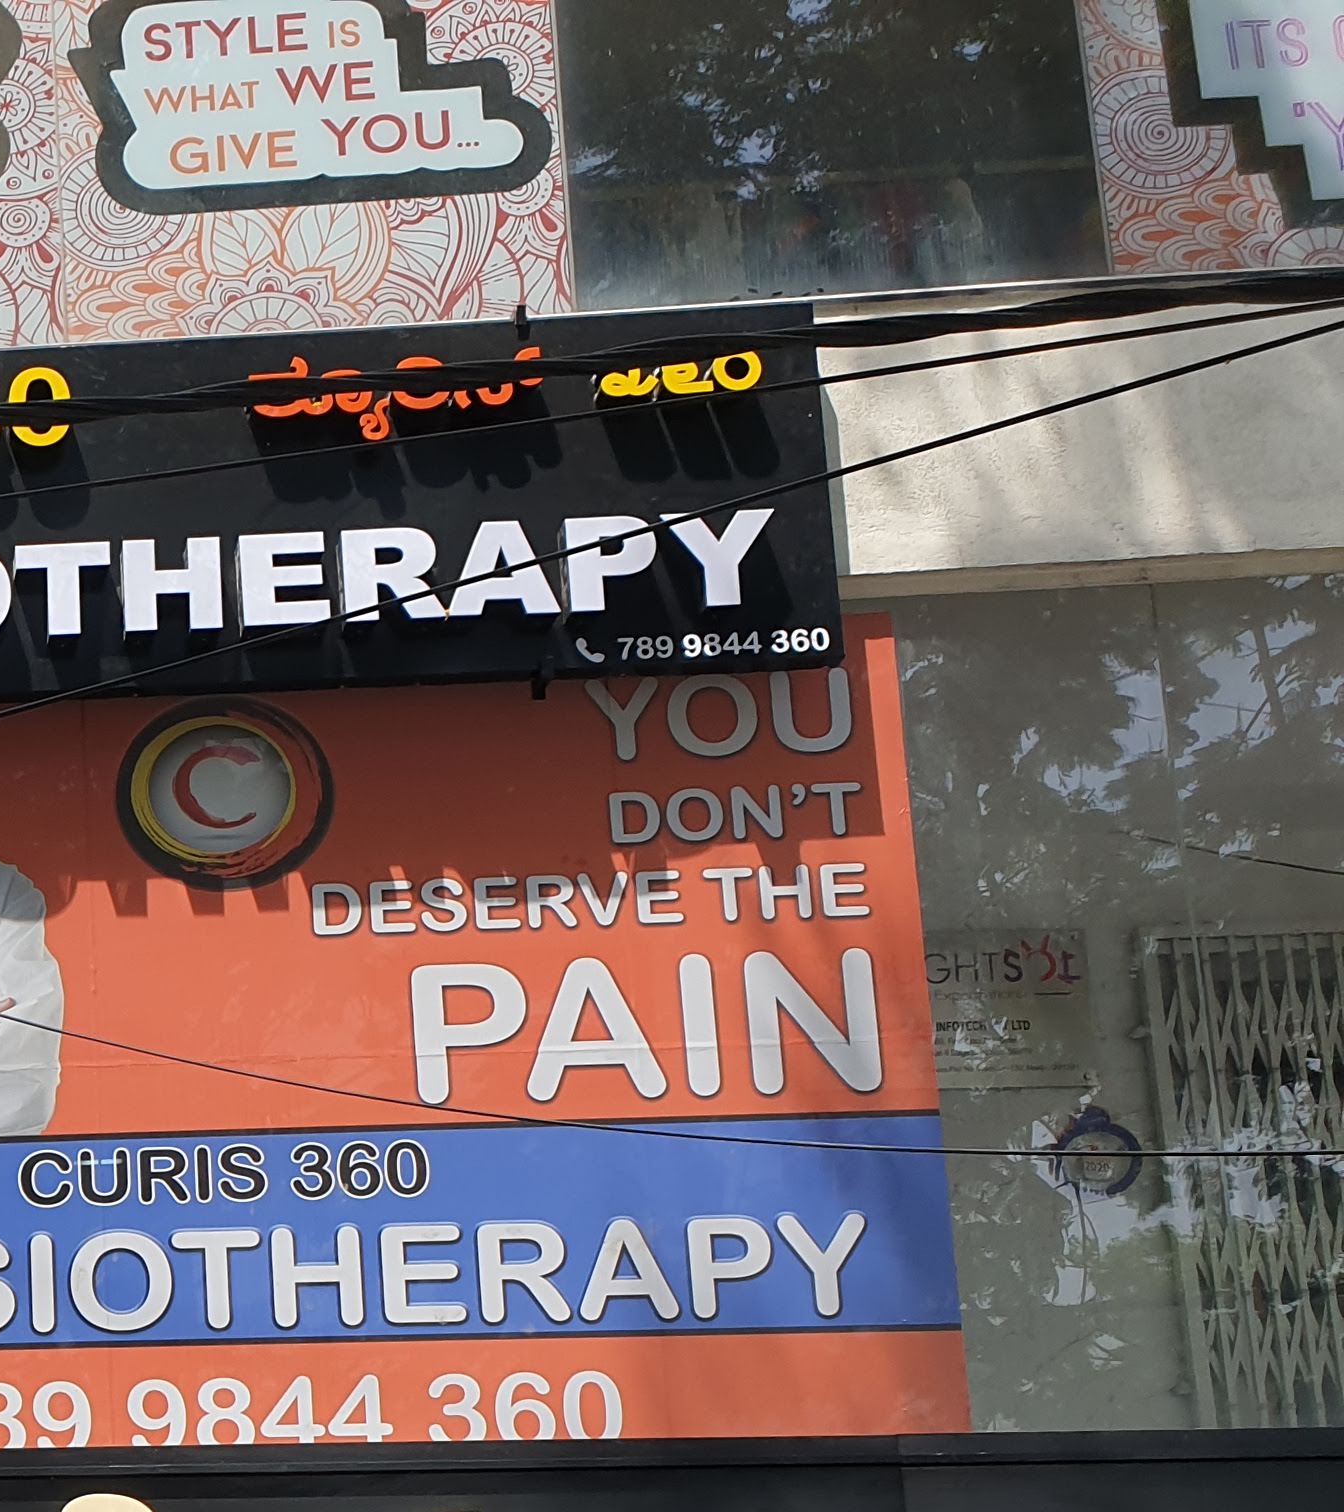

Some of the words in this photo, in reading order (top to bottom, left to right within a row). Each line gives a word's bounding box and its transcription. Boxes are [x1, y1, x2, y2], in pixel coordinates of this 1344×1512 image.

[143, 11, 305, 62] STYLE
[327, 20, 361, 49] IS
[1225, 18, 1309, 70] ITS
[143, 81, 259, 115] WHAT
[275, 61, 375, 102] WE
[168, 128, 298, 172] GIVE
[616, 635, 675, 661] 789
[682, 631, 763, 658] 9844
[770, 626, 832, 655] 360
[584, 665, 855, 763] YOU
[311, 868, 686, 937] DESERVE
[703, 862, 871, 924] THE
[410, 947, 884, 1106] PAIN
[17, 1142, 272, 1210] CURIS
[288, 1137, 431, 1201] 360
[126, 1373, 394, 1446] 9844
[428, 1369, 624, 1443] 360
